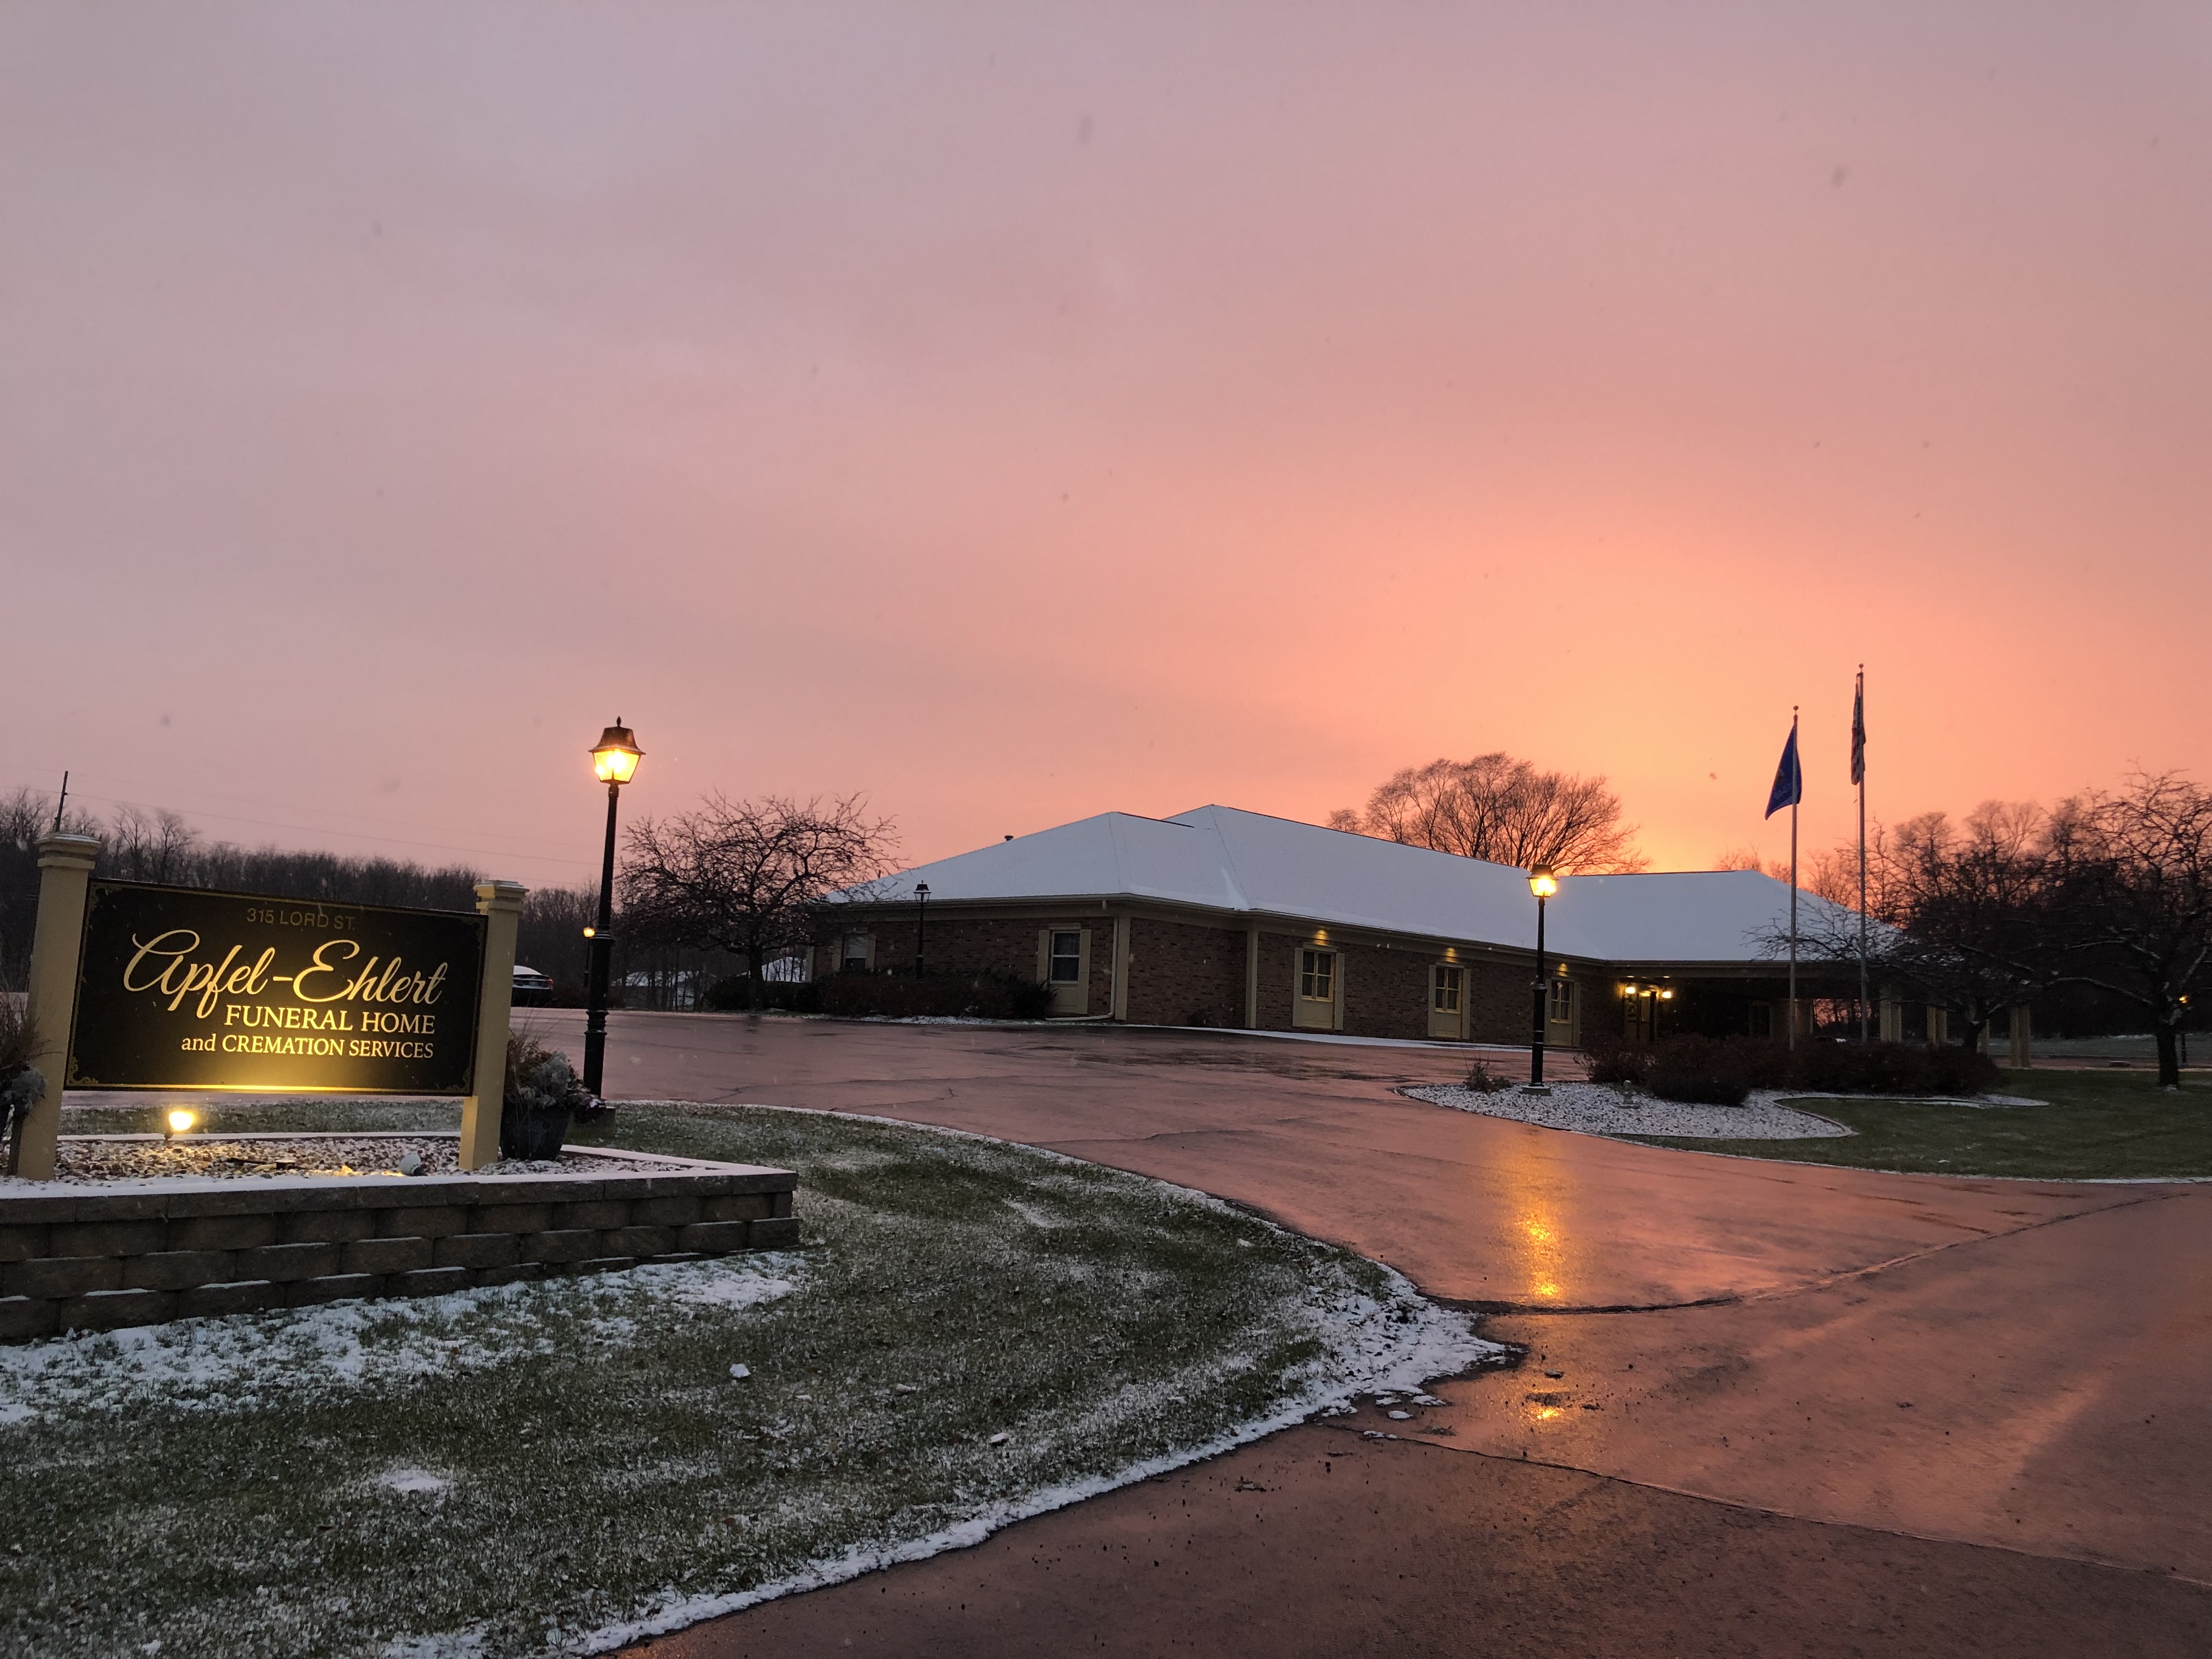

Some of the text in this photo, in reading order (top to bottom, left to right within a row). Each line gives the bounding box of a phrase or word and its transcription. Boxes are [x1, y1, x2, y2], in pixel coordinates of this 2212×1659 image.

[247, 907, 356, 930] 315 LORD ST.
[123, 929, 448, 1019] Apfel-Ehlert
[224, 1005, 435, 1034] FUNERAL HOME
[181, 1034, 433, 1059] and CREMATION SERVICES
